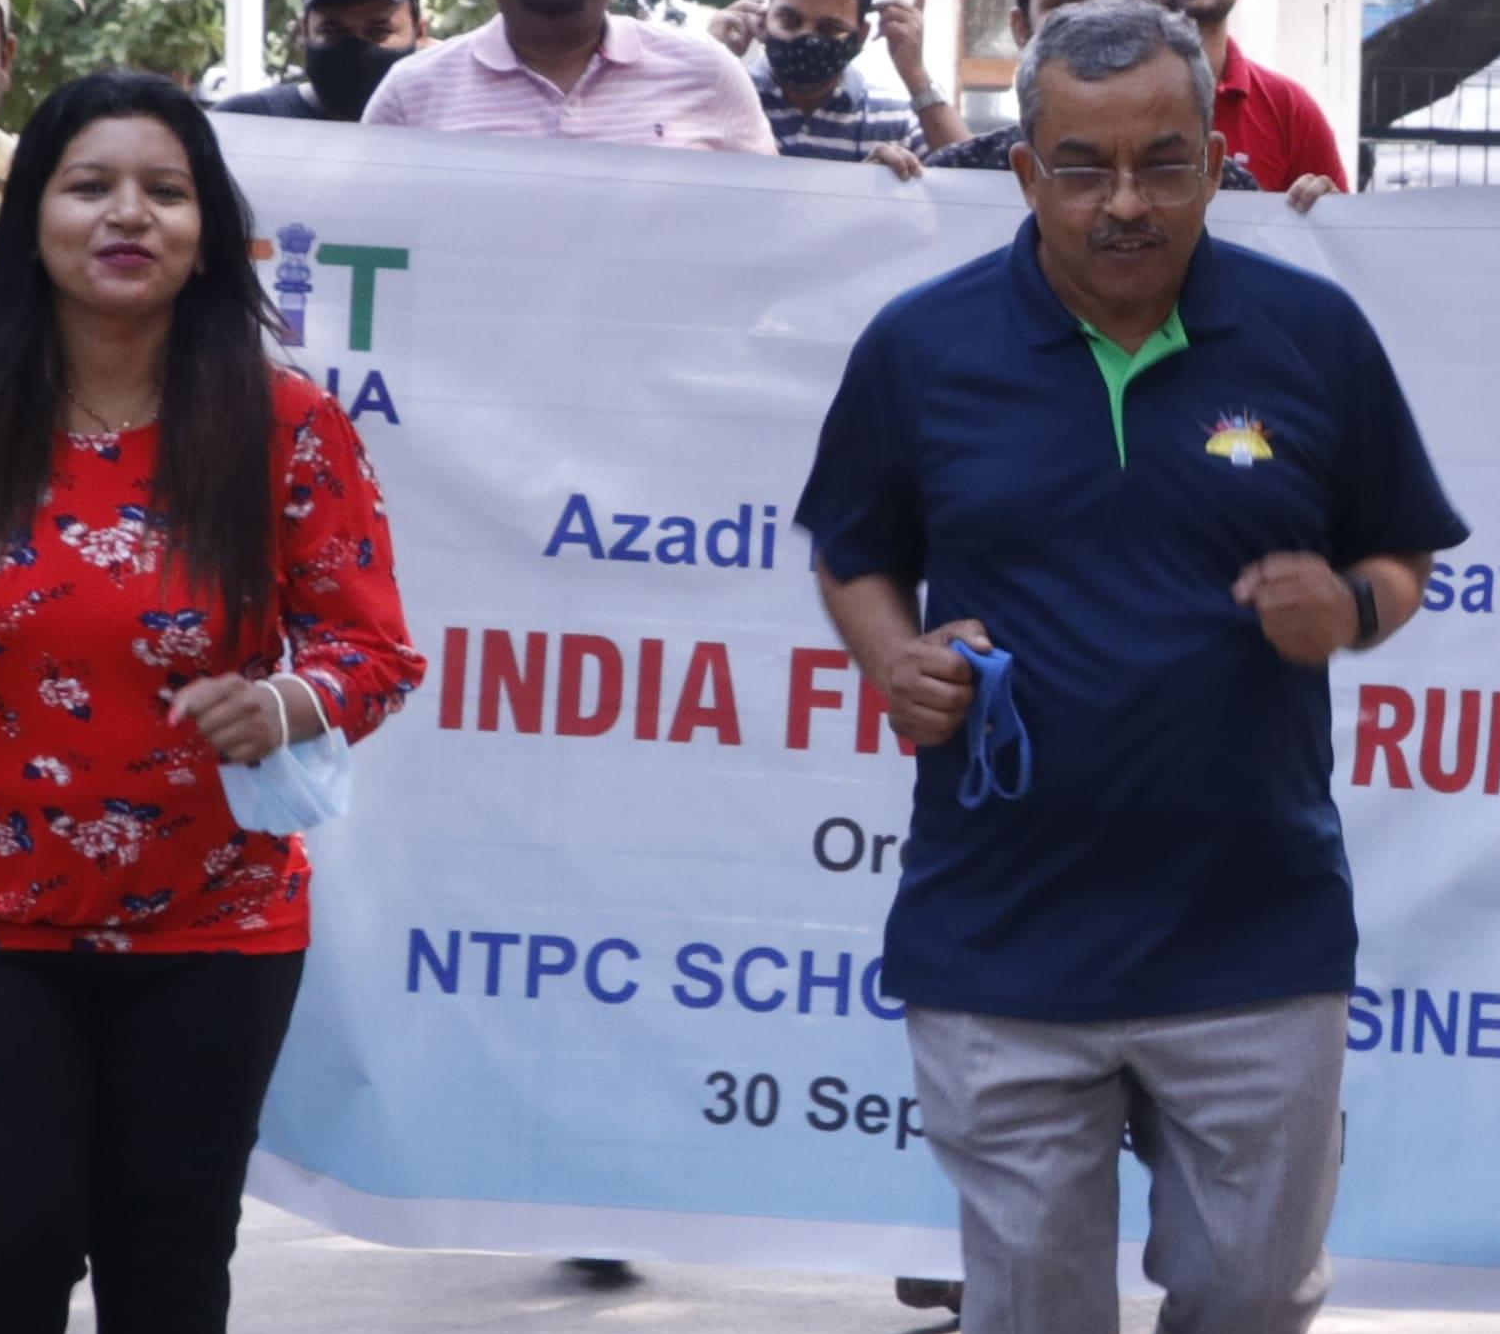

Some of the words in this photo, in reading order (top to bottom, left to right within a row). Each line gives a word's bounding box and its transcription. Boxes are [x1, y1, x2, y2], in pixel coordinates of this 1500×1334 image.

[249, 223, 410, 352] IT
[543, 494, 777, 569] Azadi
[438, 627, 741, 745] INDIA
[812, 817, 908, 877] Or
[405, 927, 641, 1005] NTPC
[702, 1071, 780, 1128] 30
